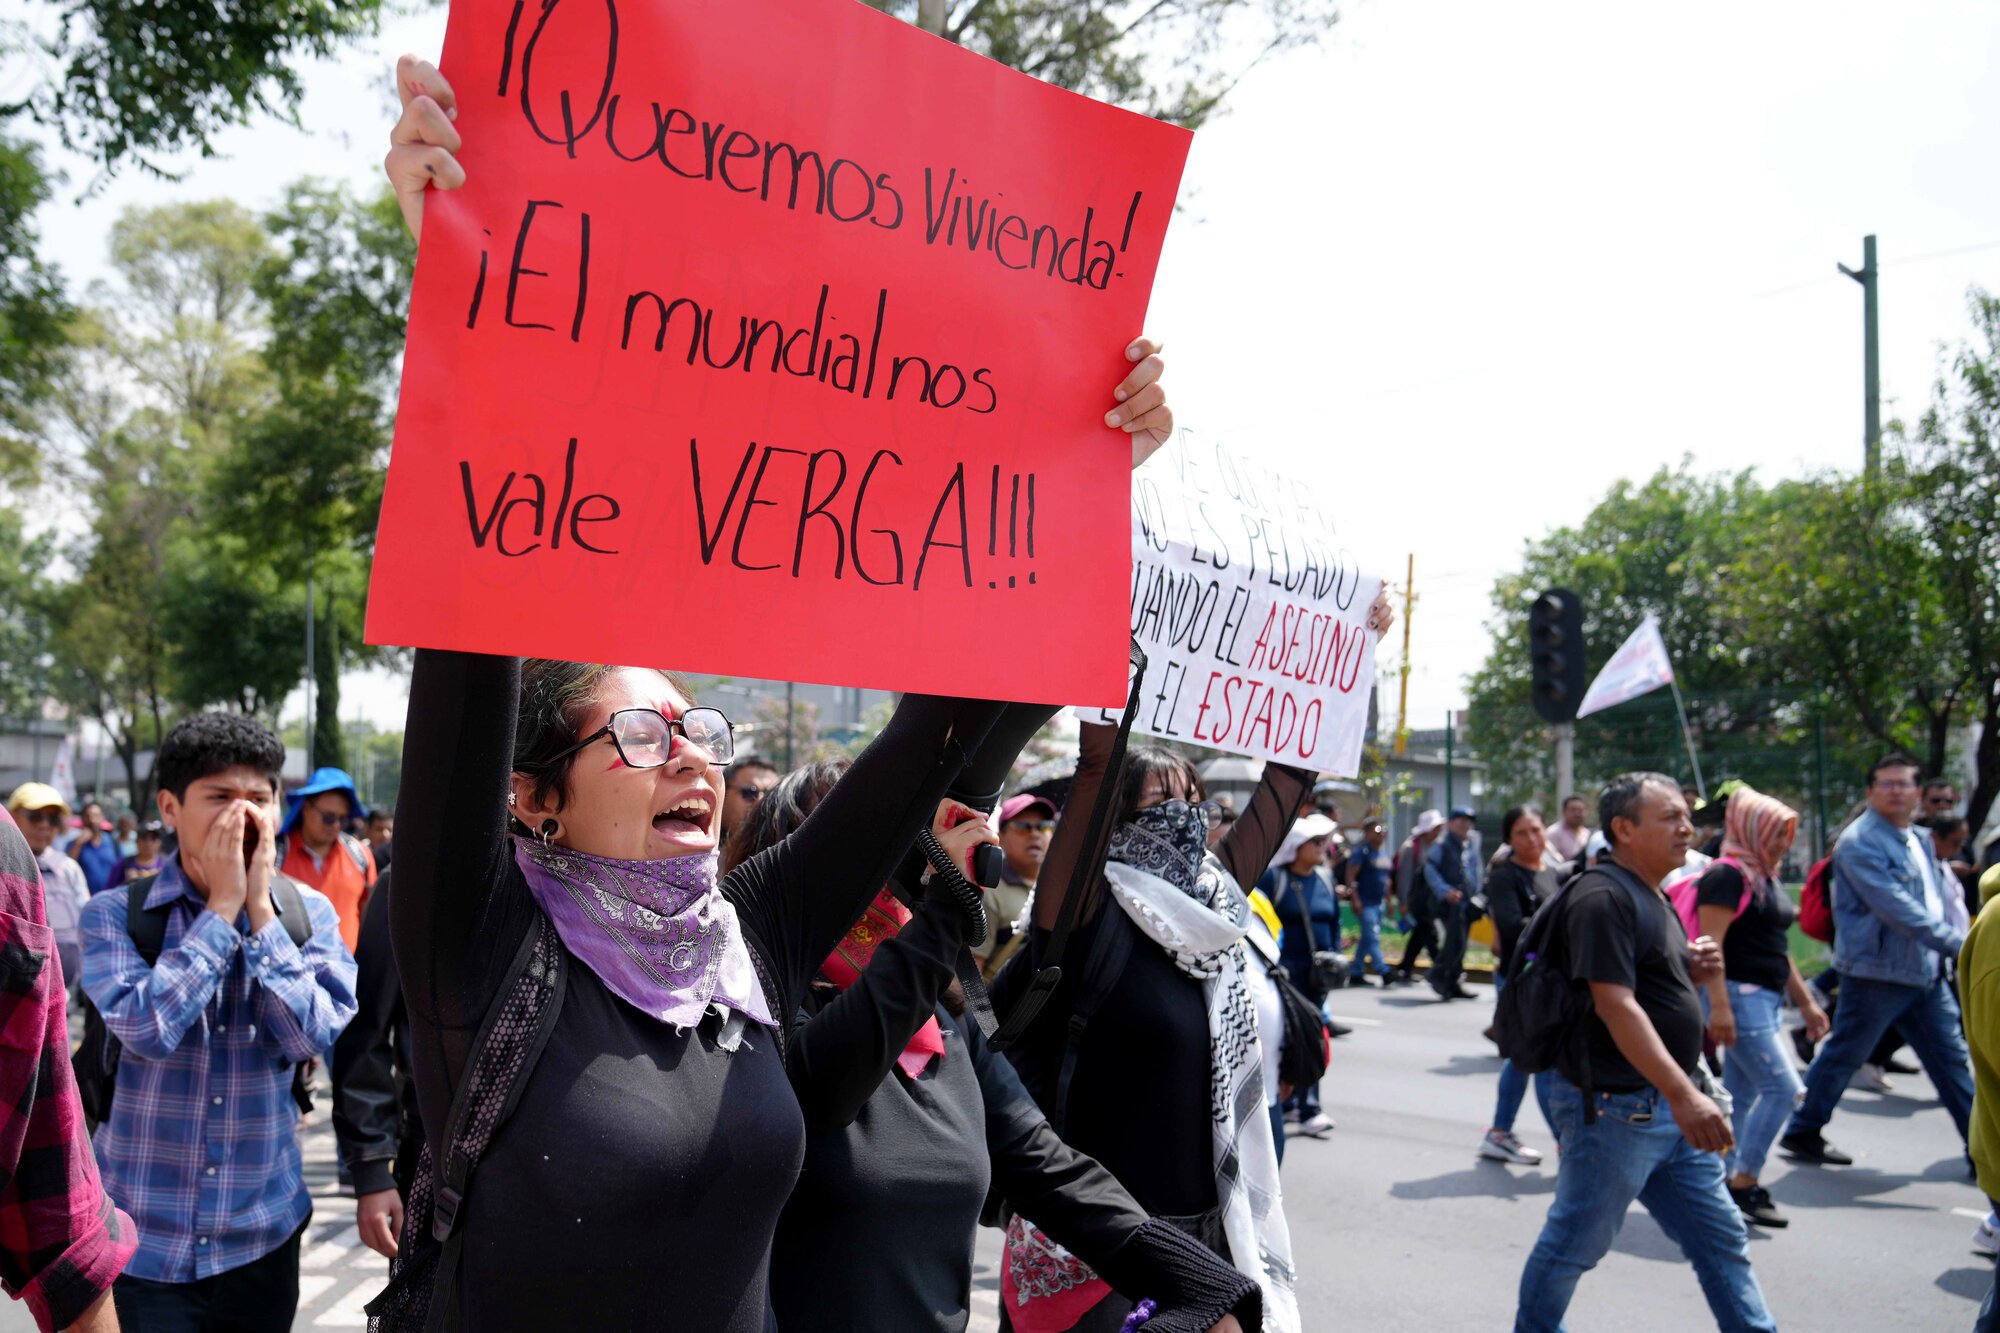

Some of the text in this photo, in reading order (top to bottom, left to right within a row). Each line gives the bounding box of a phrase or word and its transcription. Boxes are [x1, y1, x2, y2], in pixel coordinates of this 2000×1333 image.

[924, 166, 1143, 291] Vivienda!
[466, 199, 998, 414] ¡El mundial nos
[458, 437, 1037, 591] vale VERGA!!!
[1182, 494, 1230, 570] ES
[1241, 513, 1360, 611] PECADO
[1131, 560, 1366, 693] UANDO EL ASESINO
[1150, 660, 1187, 736] EL
[1193, 671, 1323, 759] ESTADO
